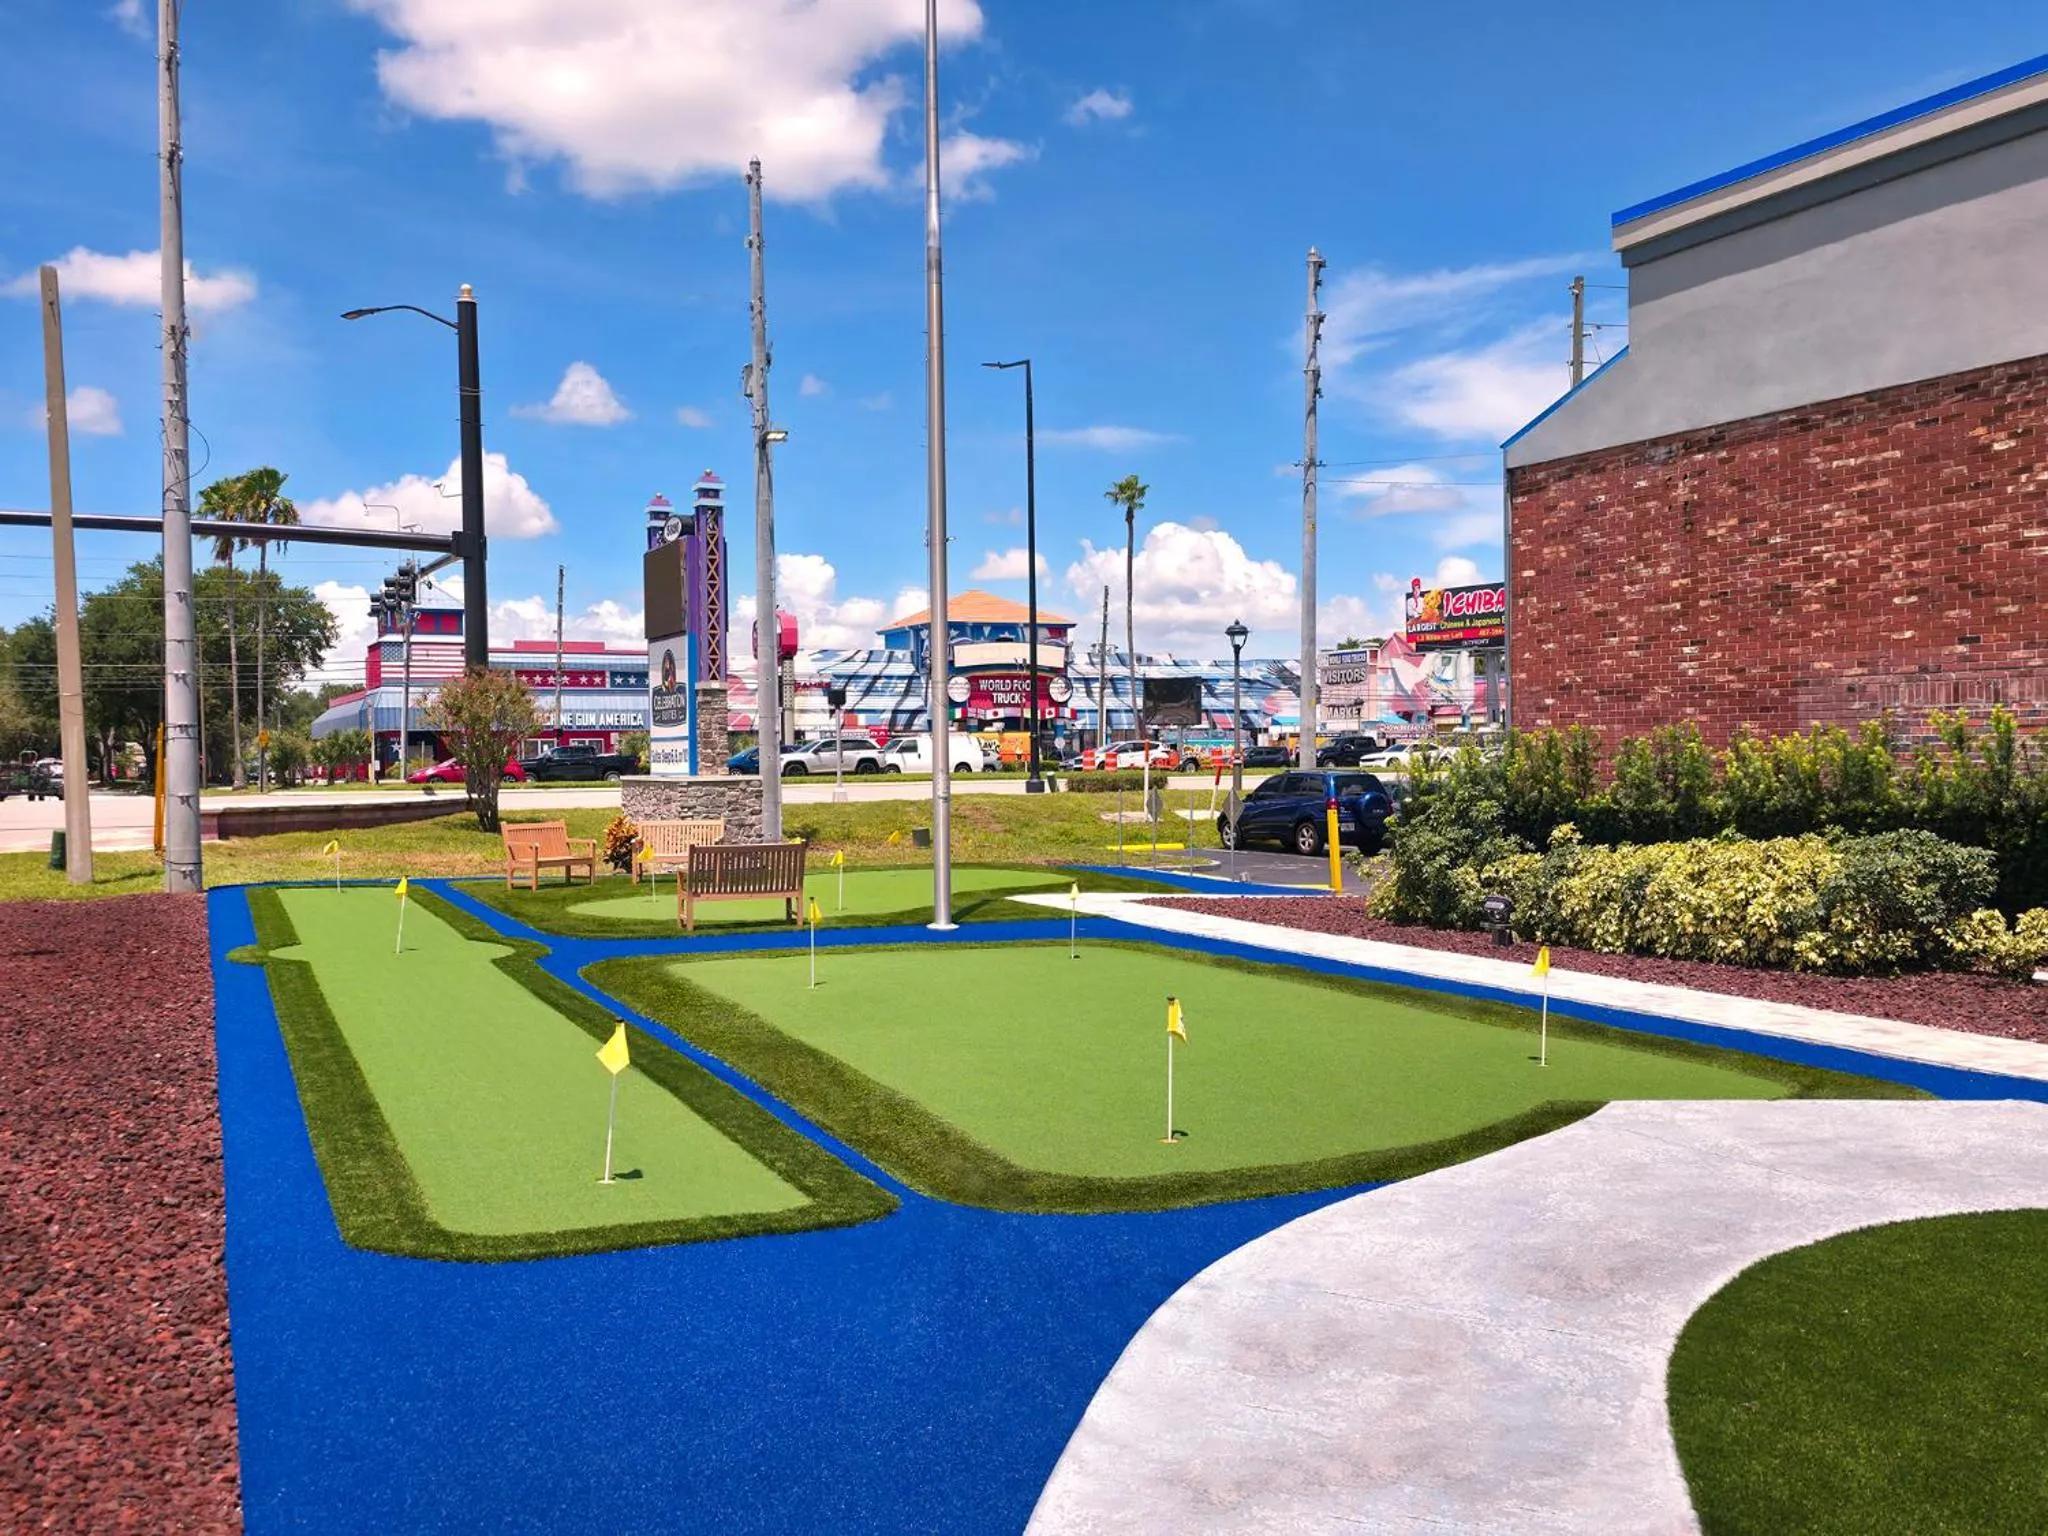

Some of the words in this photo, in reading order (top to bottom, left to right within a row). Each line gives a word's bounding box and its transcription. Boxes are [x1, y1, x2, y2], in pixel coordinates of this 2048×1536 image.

[1407, 622, 1437, 633] LARGEST
[1322, 668, 1367, 683] VISITORS
[979, 679, 1012, 691] WORLD
[1013, 679, 1031, 691] FOO
[575, 712, 596, 726] GUN
[599, 712, 644, 726] AMERICA
